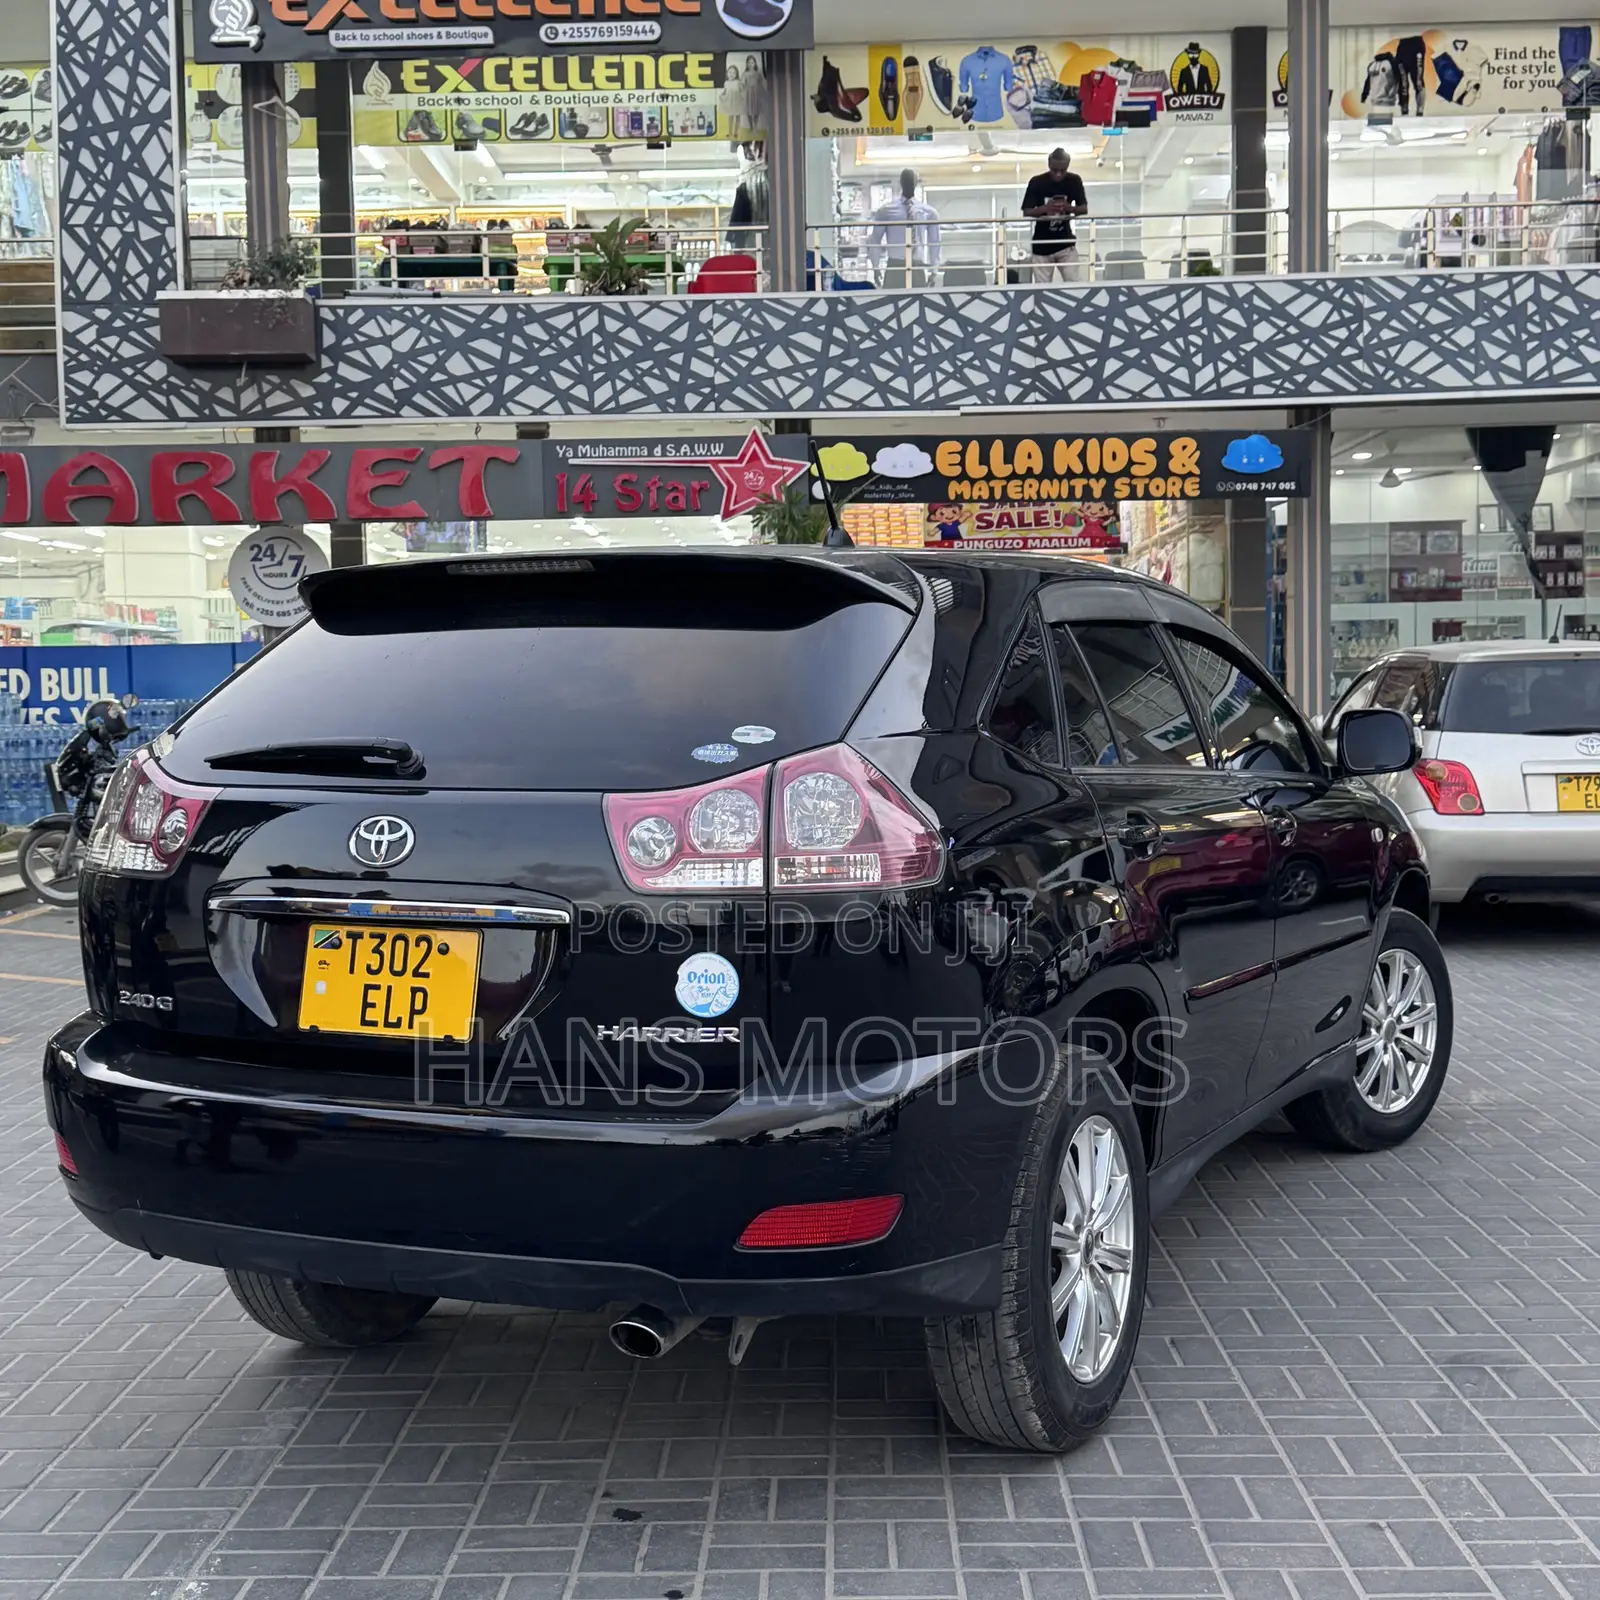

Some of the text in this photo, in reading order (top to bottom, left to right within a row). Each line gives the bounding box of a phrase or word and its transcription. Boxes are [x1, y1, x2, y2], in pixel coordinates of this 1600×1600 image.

[334, 29, 489, 42] Back to school shoes & Boutique
[561, 21, 656, 39] +255769159444
[1494, 46, 1556, 60] Find the
[401, 53, 714, 94] EXCELLENCE
[1487, 61, 1556, 77] best style
[1503, 77, 1525, 90] for
[417, 95, 453, 107] Back
[475, 94, 523, 106] school
[529, 95, 540, 105] &
[544, 93, 609, 107] Boutique
[613, 94, 624, 104] &
[628, 92, 697, 104] Perfumes
[1175, 112, 1214, 122] MAVAZI
[556, 445, 574, 458] Ya
[666, 443, 724, 456] S.A.W.W
[935, 436, 1200, 479] ELLA KIDS &
[555, 472, 710, 513] 14 Star
[948, 476, 1200, 500] MATERNITY STORE
[975, 509, 1064, 532] SALE!
[953, 537, 1092, 550] PUNGUZO MAALUM
[40, 667, 116, 702] BULL
[346, 930, 433, 979] T302
[687, 968, 726, 985] Orion
[360, 983, 429, 1030] ELP
